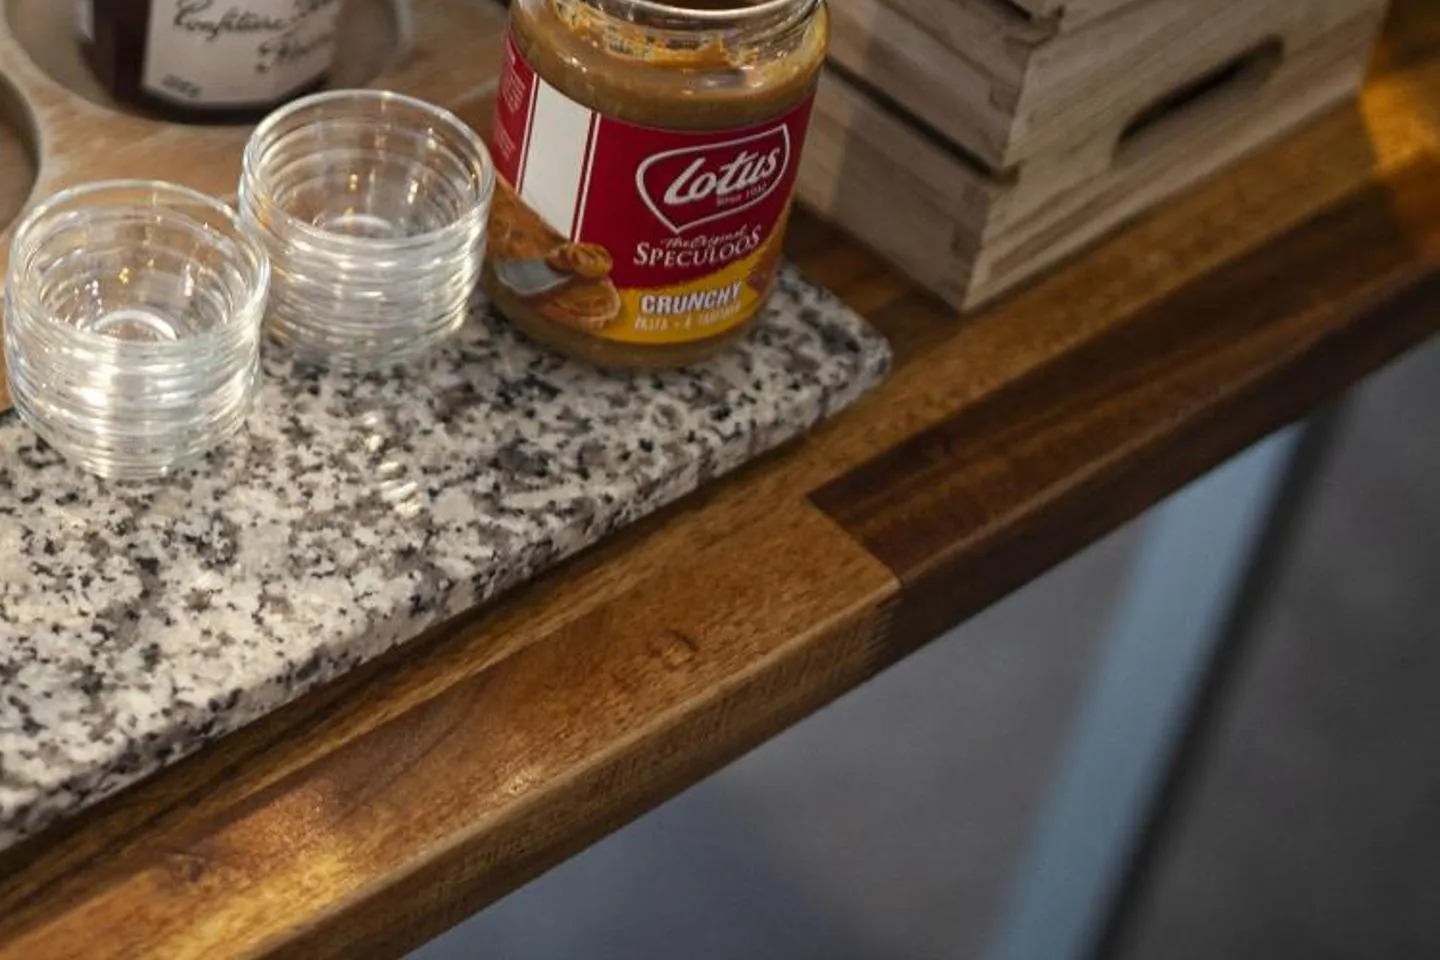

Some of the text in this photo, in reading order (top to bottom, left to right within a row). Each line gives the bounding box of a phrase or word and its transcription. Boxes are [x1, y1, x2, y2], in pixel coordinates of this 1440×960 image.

[663, 147, 781, 206] Lotus
[633, 224, 762, 268] SPECULOOS
[640, 280, 742, 315] CRUNCHY
